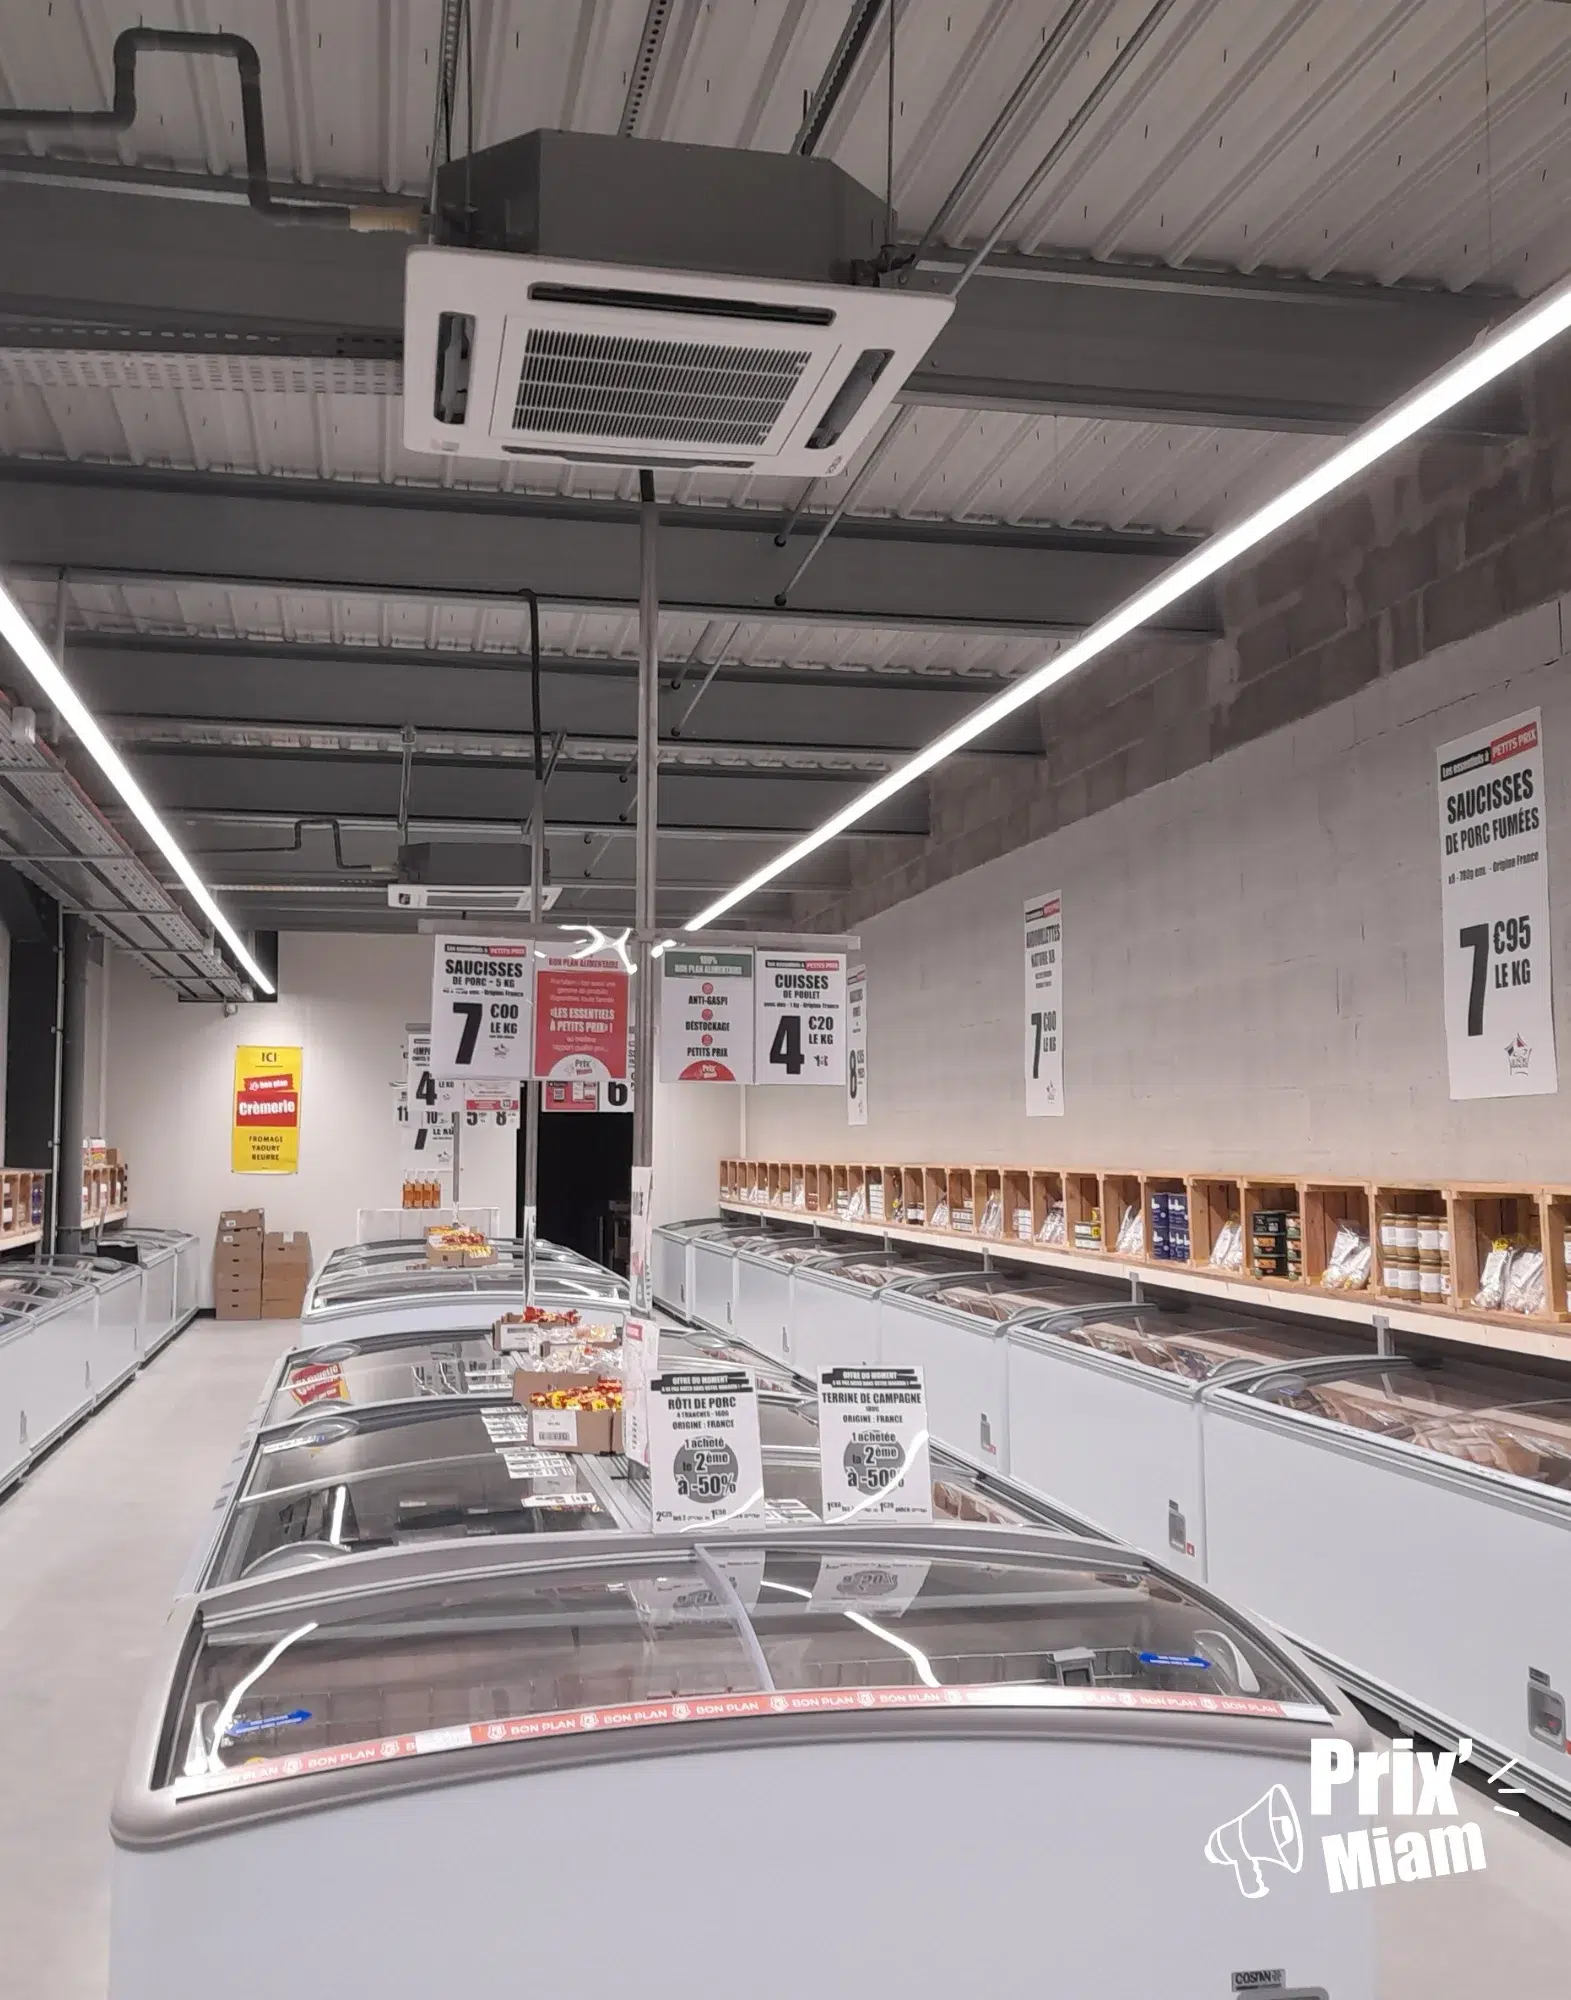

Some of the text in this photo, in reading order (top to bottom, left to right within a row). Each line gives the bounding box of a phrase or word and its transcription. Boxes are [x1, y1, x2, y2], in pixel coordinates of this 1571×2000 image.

[1492, 739, 1518, 758] PETITS
[1518, 729, 1537, 748] PRIX
[1447, 768, 1534, 825] SAUCISSES
[1445, 806, 1540, 855] DE PORC FUMÉES
[1516, 851, 1539, 866] France
[1493, 915, 1531, 955] €95
[445, 959, 523, 978] SAUCISSES
[563, 958, 579, 967] PLAN
[1459, 923, 1489, 1037] 7
[1494, 958, 1531, 989] LE KG
[452, 976, 515, 988] DE PORC 5 KG
[775, 973, 829, 989] CUISSES
[688, 995, 728, 1005] ANTI-GASPI
[783, 990, 821, 999] DE POULET
[569, 1008, 615, 1020] ESSENTIELS
[490, 1022, 518, 1034] LE KG
[557, 1020, 585, 1033] PETITS
[685, 1020, 730, 1031] DÉSTOCKAGE
[808, 1016, 834, 1031] €20
[453, 1002, 483, 1065] 7
[808, 1034, 834, 1045] LE KG
[687, 1047, 729, 1057] PETITS PRIX
[769, 1015, 805, 1075] 4
[1031, 1012, 1042, 1079] 7
[261, 1052, 277, 1063] ICI
[415, 1071, 438, 1106] 4
[239, 1099, 296, 1116] Crèmerie
[251, 1153, 280, 1161] BEURRE
[701, 1375, 729, 1384] MOMENT
[668, 1396, 736, 1410] RÔTI DE PORC
[822, 1392, 922, 1404] TERRINE DE CAMPAGNE
[672, 1419, 734, 1430] ORIGINE FRANCE
[842, 1415, 903, 1423] ORIGINE FRANCE
[684, 1437, 724, 1448] 1 acheté
[852, 1432, 896, 1442] 1 achetée
[682, 1452, 729, 1472] le 2ème
[852, 1446, 897, 1464] la 2ème
[847, 1467, 857, 1487] à
[677, 1475, 737, 1495] à -50%
[792, 1695, 853, 1708] BON PLAN
[880, 1691, 941, 1703] BON PLAN
[1140, 1696, 1197, 1708] BON PLAN
[696, 1701, 759, 1715] BON PLAN
[1221, 1702, 1279, 1714] BON PLAN
[603, 1708, 668, 1725] BON PLAN
[511, 1718, 576, 1735] BON PLAN
[308, 1748, 375, 1769] BON PLAN
